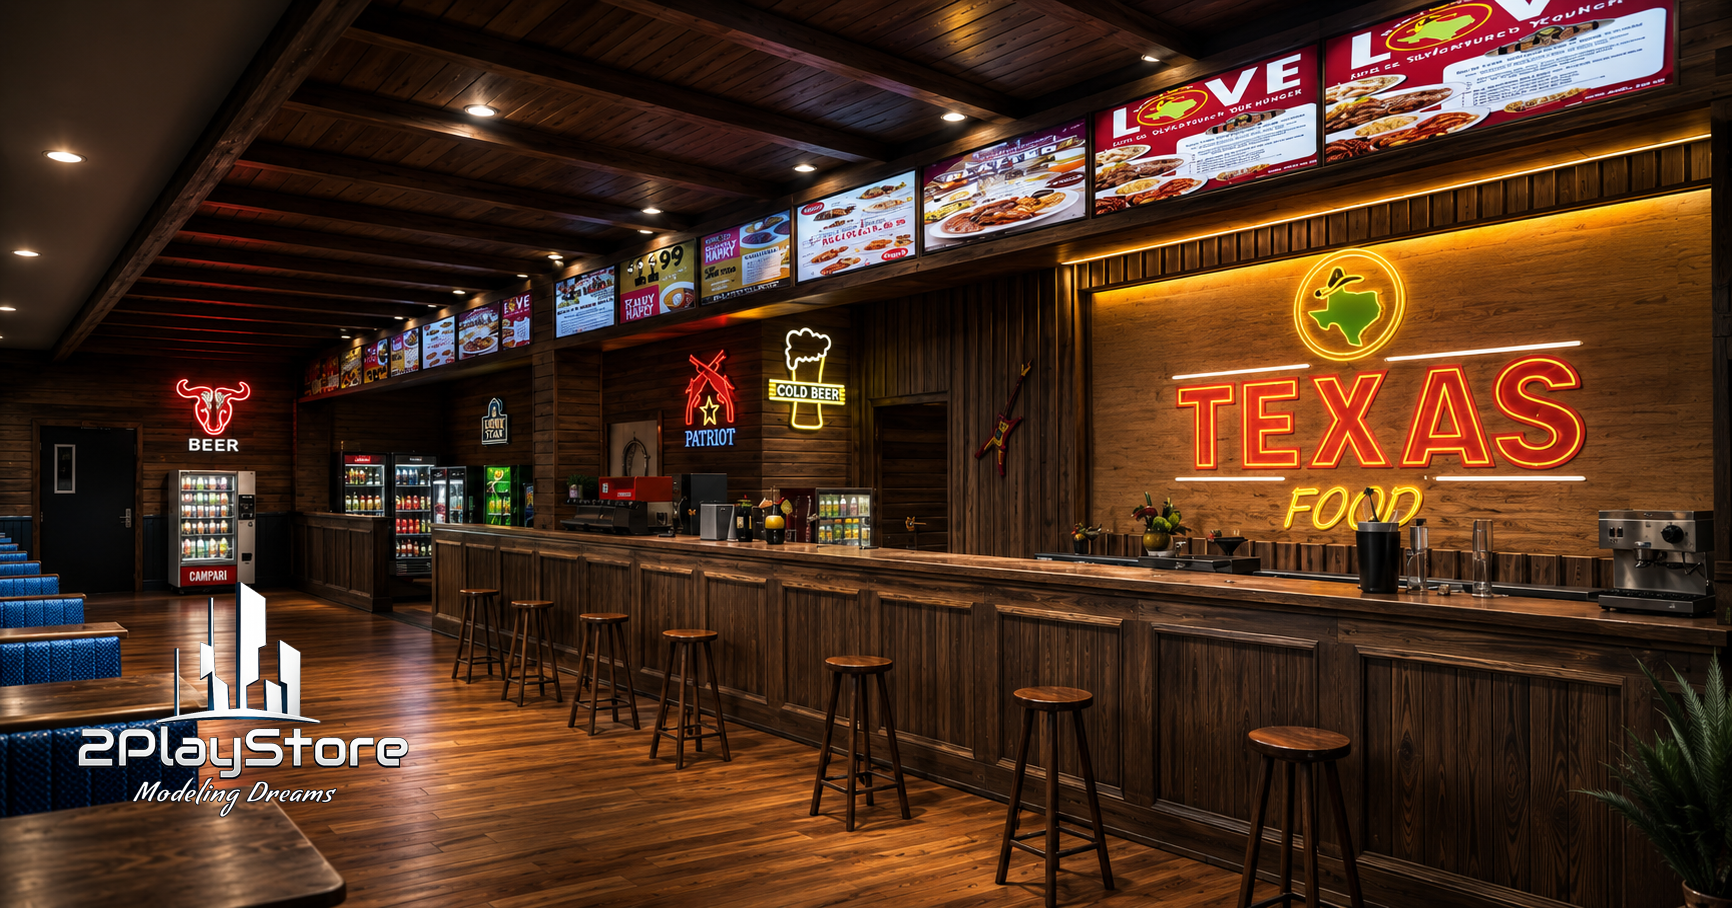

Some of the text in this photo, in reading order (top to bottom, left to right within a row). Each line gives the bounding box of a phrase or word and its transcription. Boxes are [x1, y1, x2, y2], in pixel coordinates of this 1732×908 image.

[776, 383, 840, 401] COLD BEER
[1176, 354, 1587, 470] TEXAS
[188, 437, 239, 452] BEER
[684, 427, 736, 447] PATRIOT
[1283, 485, 1425, 532] FOOD
[189, 570, 228, 582] CAMPARI
